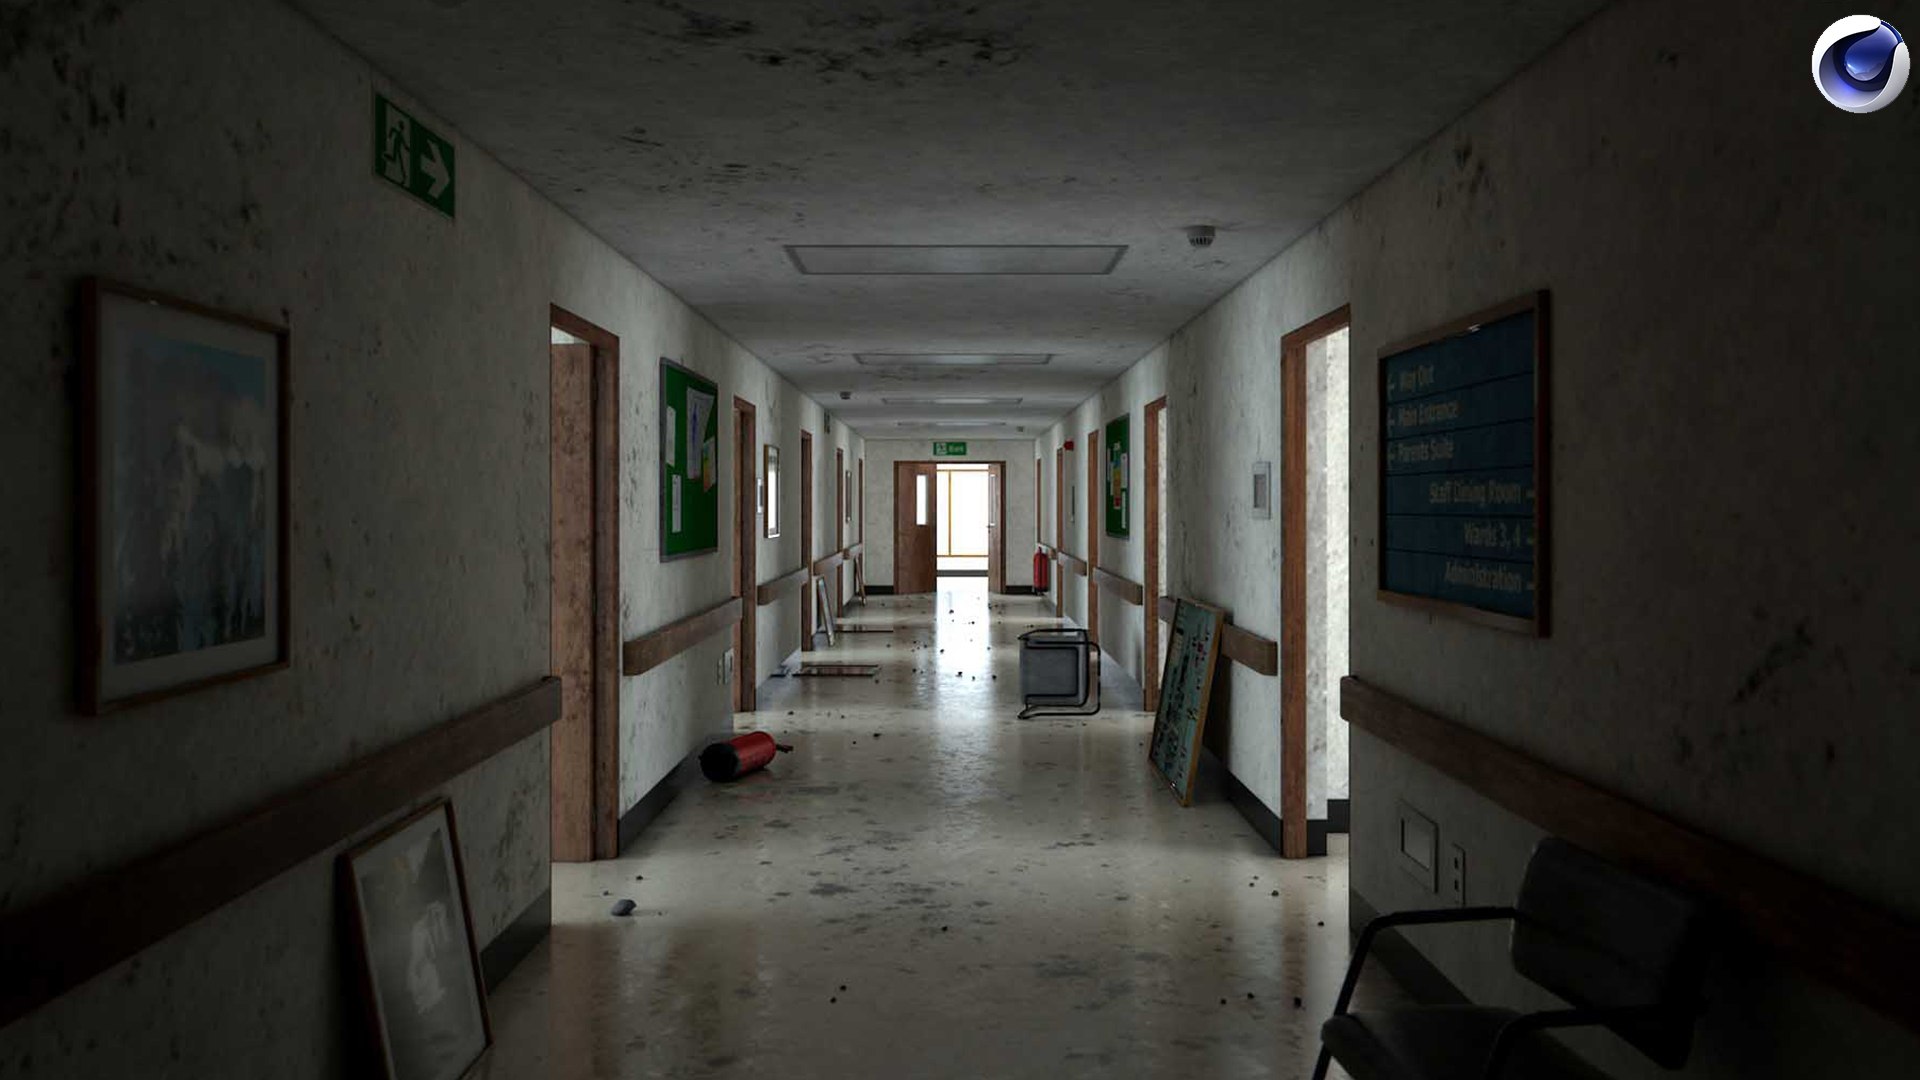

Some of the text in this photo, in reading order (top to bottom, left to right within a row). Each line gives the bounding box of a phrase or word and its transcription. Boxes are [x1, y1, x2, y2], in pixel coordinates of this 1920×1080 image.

[1399, 364, 1434, 392] Way Out
[1398, 400, 1462, 426] Main Entrance
[1398, 437, 1454, 463] Parents Suite
[1429, 480, 1521, 508] Staff Dining Room
[1464, 521, 1497, 547] Wards
[1512, 522, 1521, 547] 4
[1444, 560, 1522, 593] Administration
